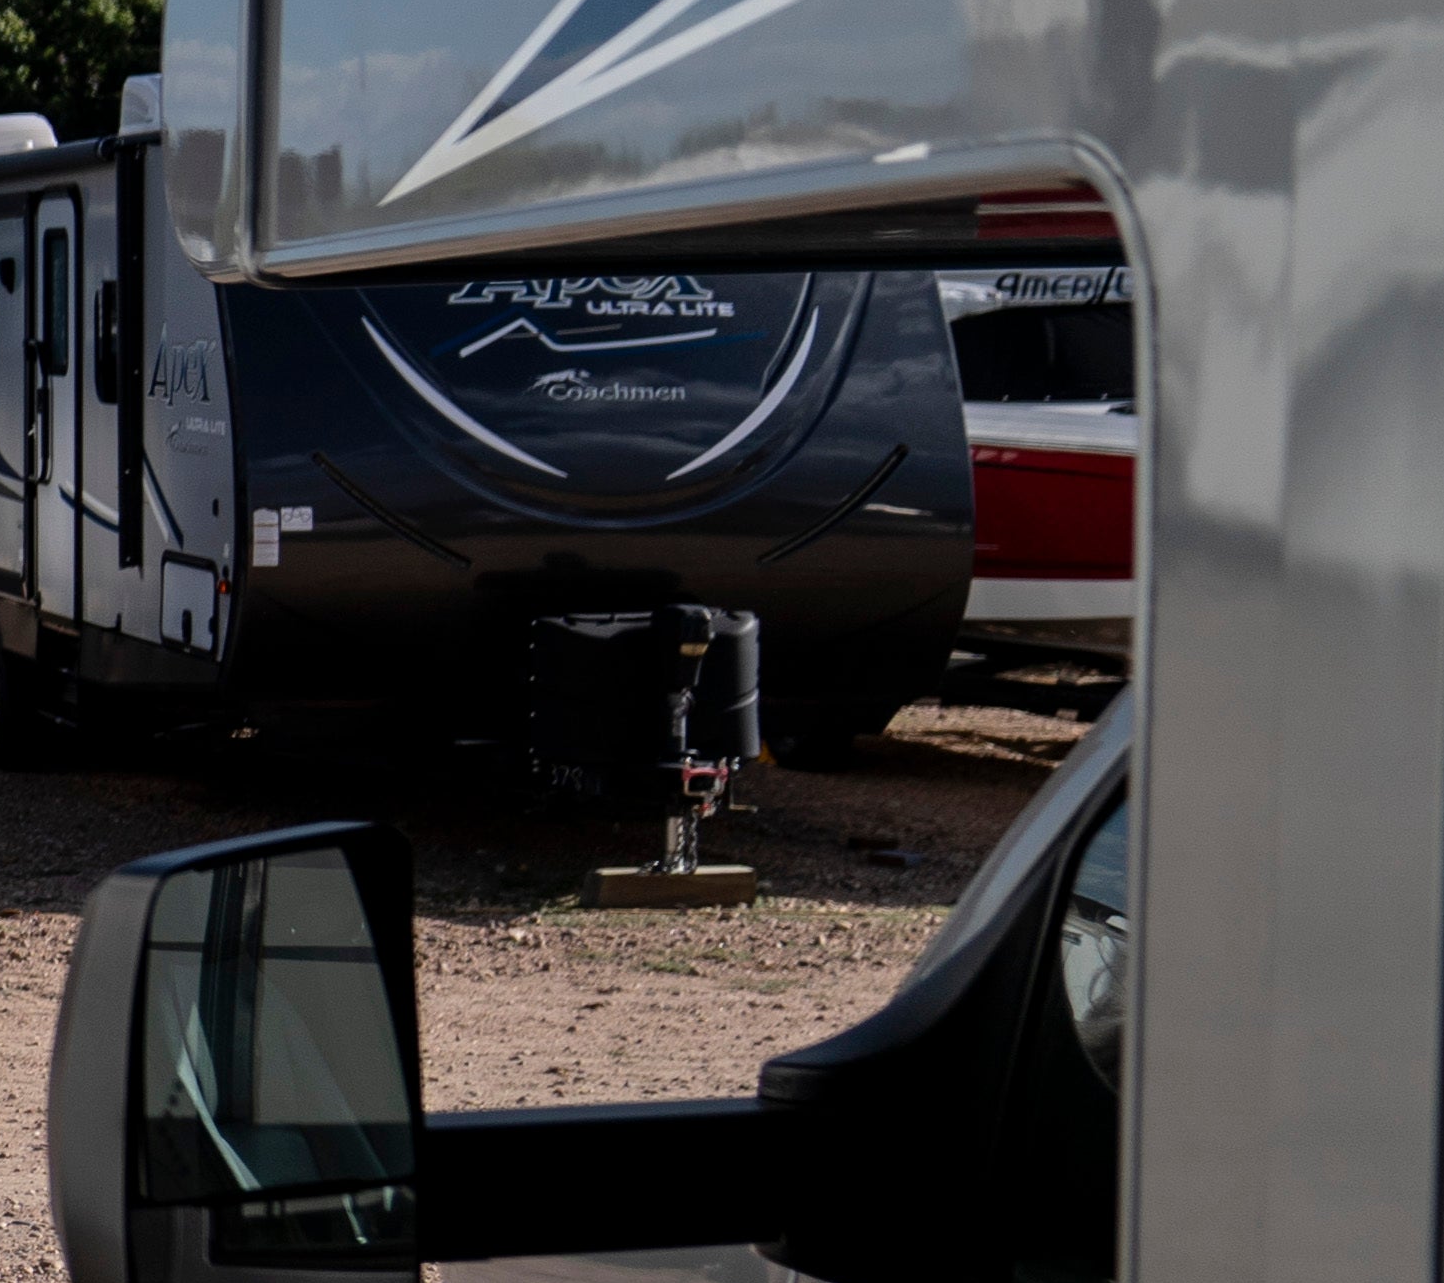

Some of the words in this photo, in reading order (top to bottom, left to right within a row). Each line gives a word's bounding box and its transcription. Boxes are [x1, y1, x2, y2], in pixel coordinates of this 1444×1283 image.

[586, 300, 675, 316] ULTRA
[679, 301, 735, 317] LITE
[147, 322, 216, 408] Apex
[548, 382, 685, 403] Coachmen
